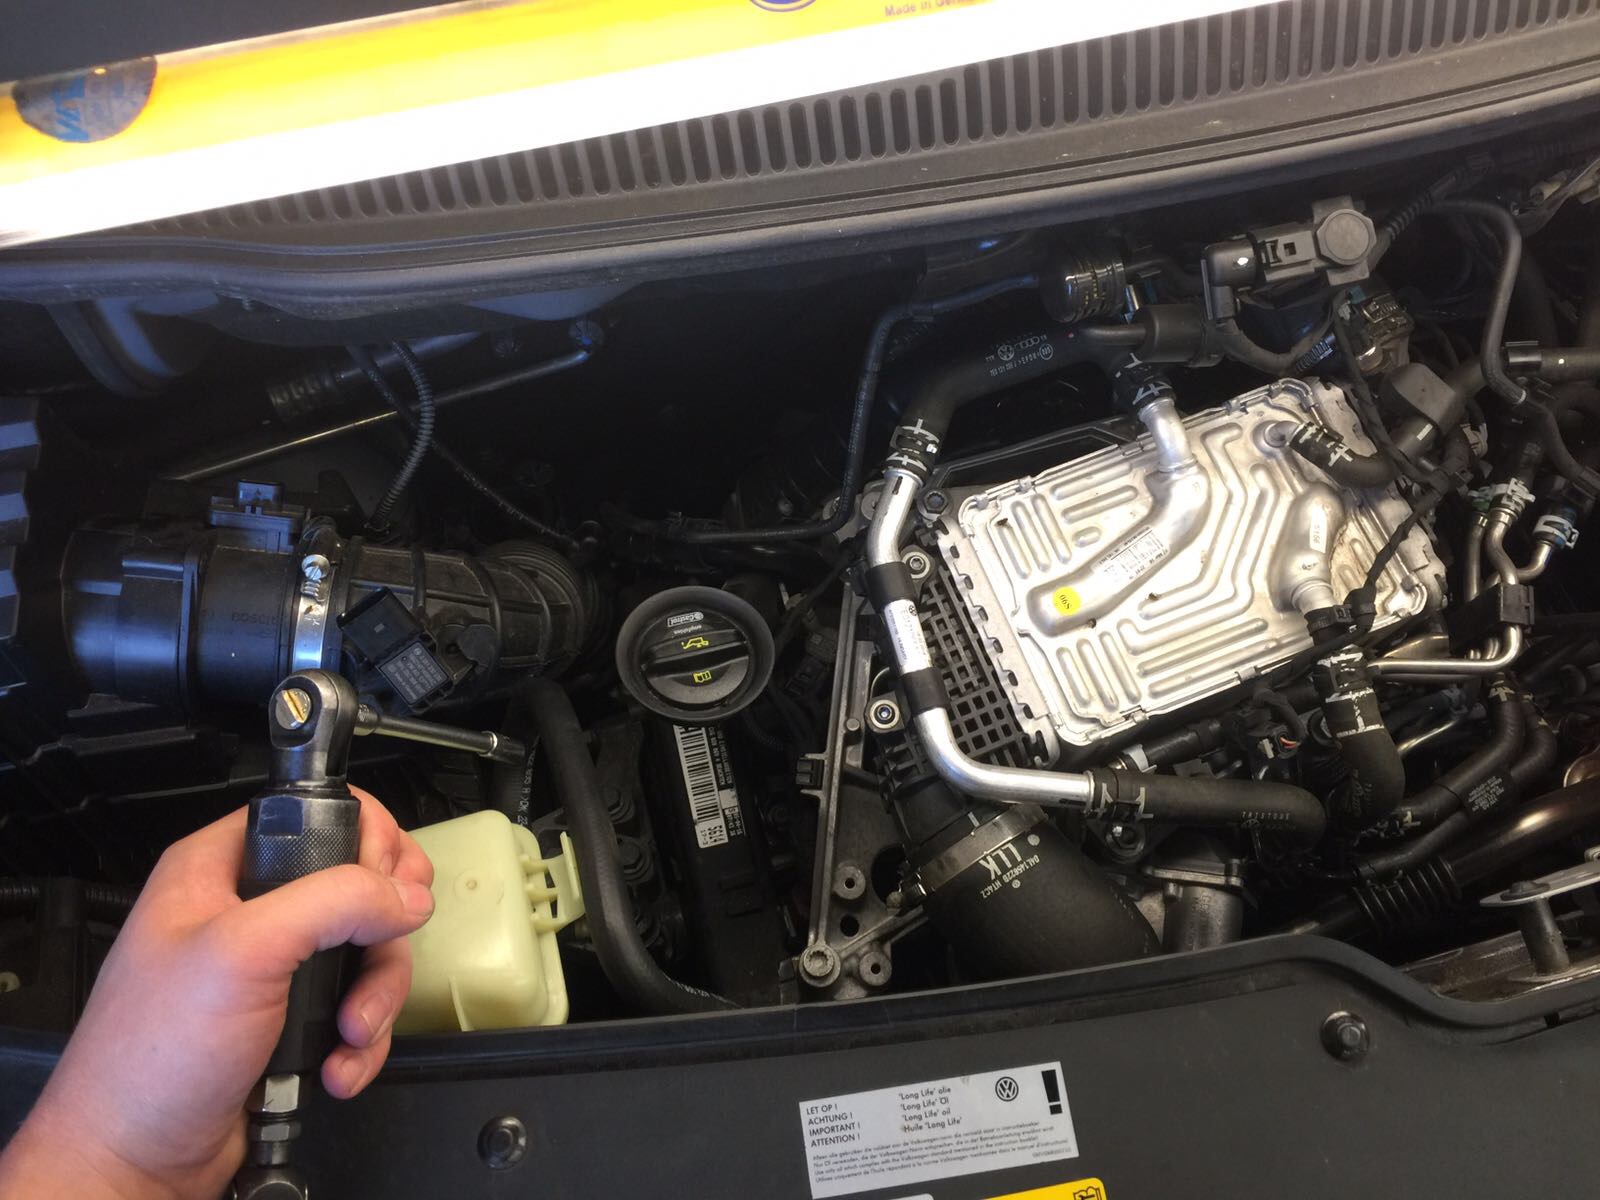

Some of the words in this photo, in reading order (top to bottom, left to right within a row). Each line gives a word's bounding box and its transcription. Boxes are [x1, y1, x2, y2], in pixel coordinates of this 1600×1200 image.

[885, 3, 916, 17] Made
[979, 842, 1022, 880] LLK
[937, 1085, 950, 1094] olie
[806, 1106, 818, 1115] LET
[821, 1104, 832, 1112] OP
[941, 1107, 951, 1115] oil
[807, 1112, 847, 1125] ACHTUNG
[809, 1122, 855, 1136] IMPORTANT
[903, 1122, 923, 1132] Huile
[810, 1133, 855, 1147] ATTENTION
